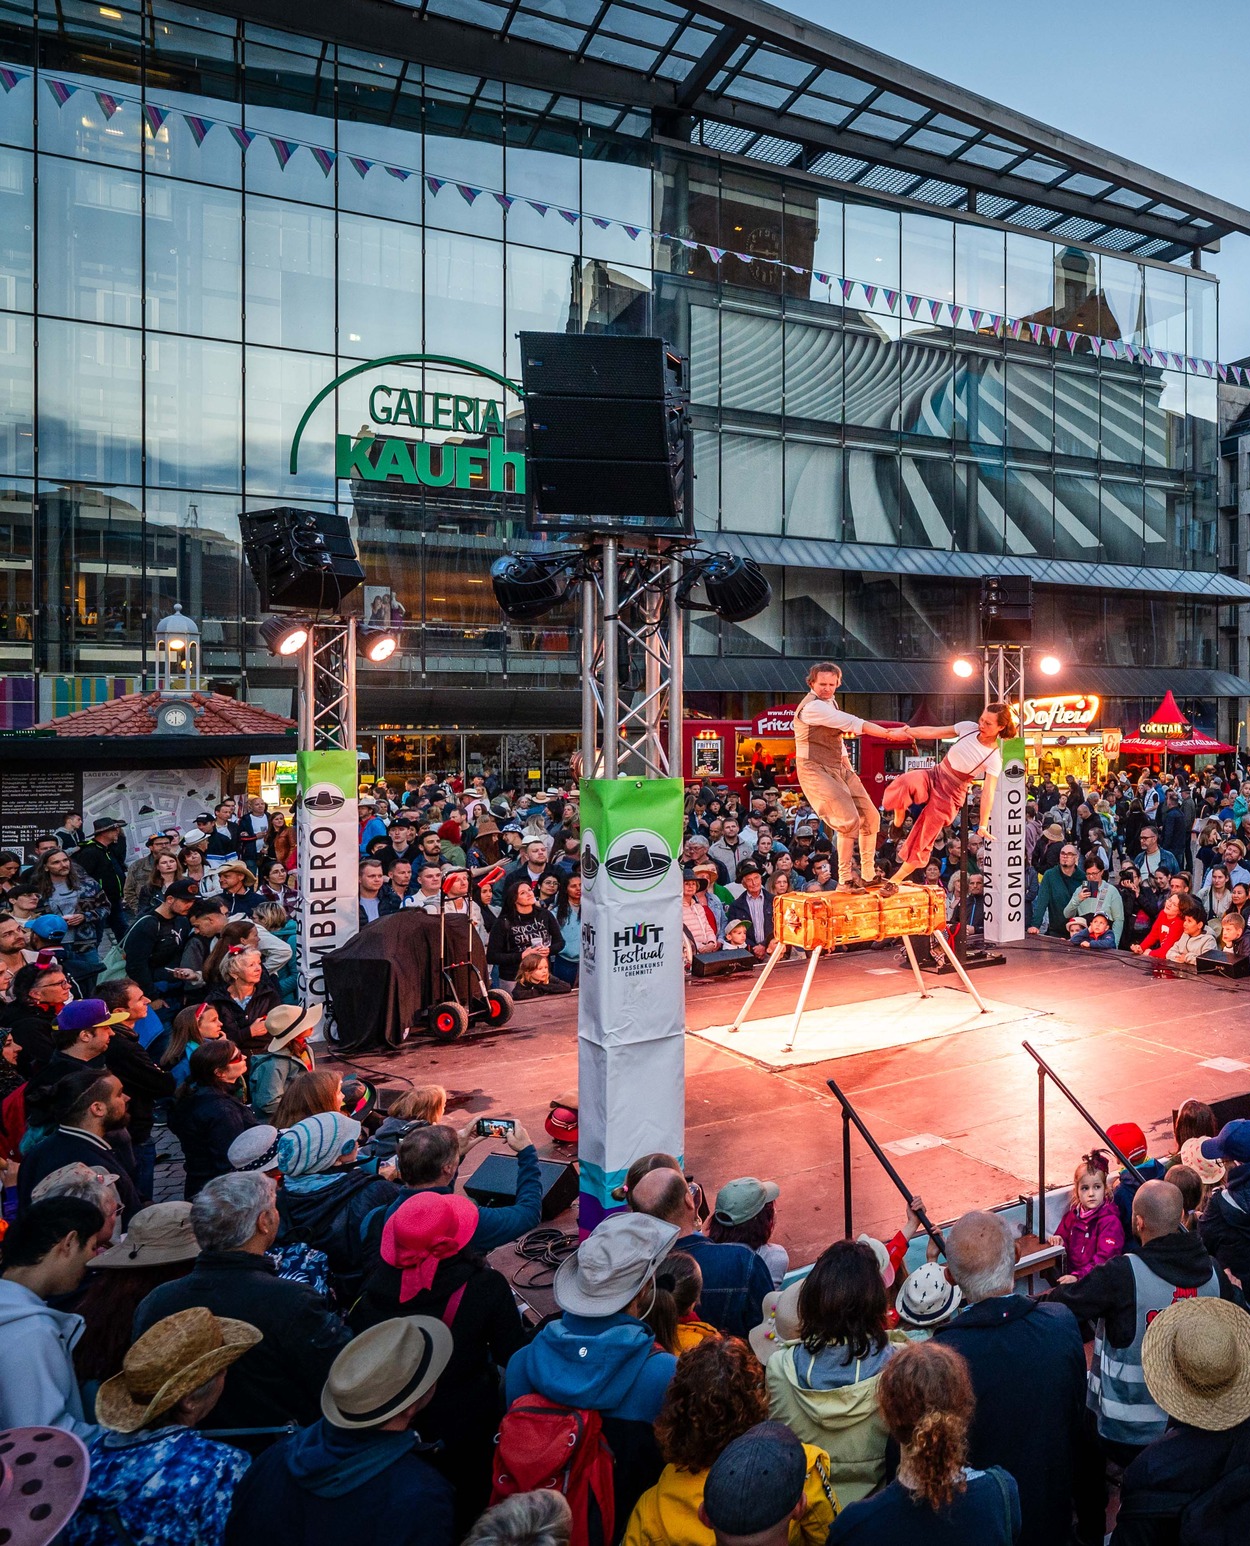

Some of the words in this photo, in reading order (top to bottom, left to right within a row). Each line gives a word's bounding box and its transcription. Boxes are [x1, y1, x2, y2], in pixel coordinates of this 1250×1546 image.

[369, 385, 503, 434] GALERIA
[1140, 723, 1183, 734] COCKTAIL
[1105, 734, 1119, 753] Eis
[1120, 737, 1162, 747] OCKTAILBAR
[1008, 789, 1022, 922] SOMBRERO
[309, 826, 337, 996] OMBRERO
[614, 922, 664, 947] HUT
[612, 942, 664, 966] Festival
[613, 961, 664, 973] STRASSENKUNST
[625, 969, 653, 977] CHEMNITZ
